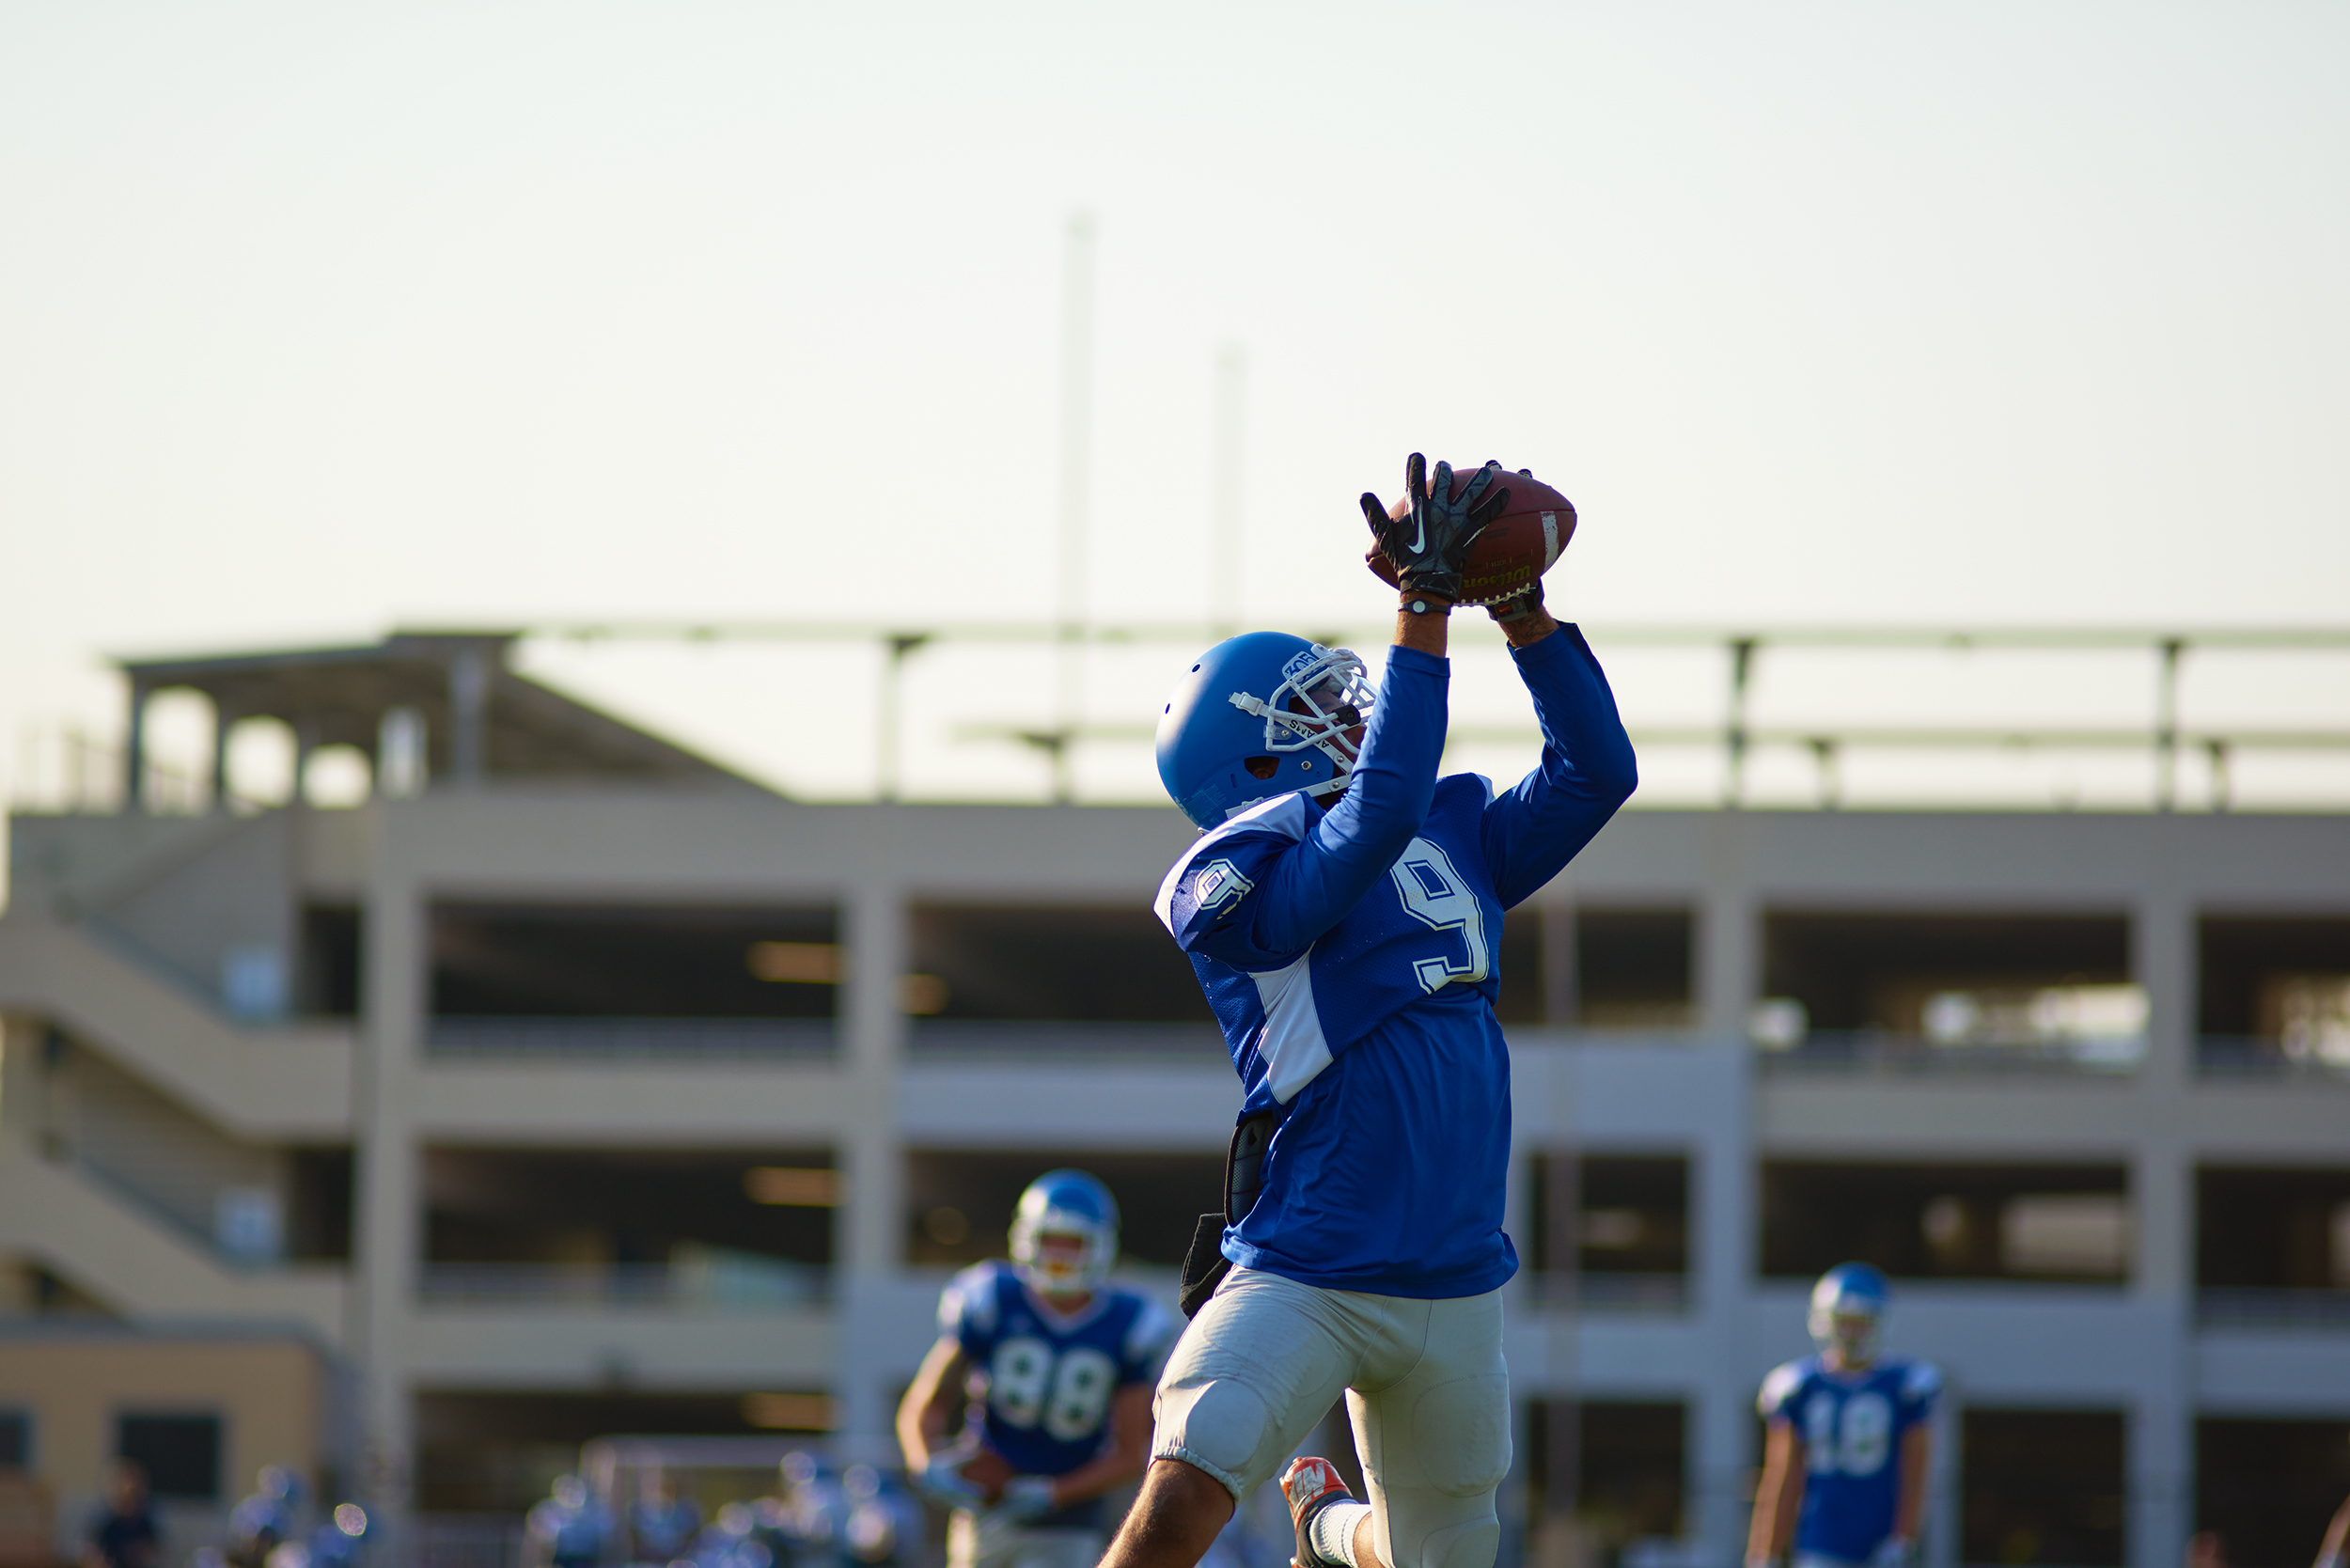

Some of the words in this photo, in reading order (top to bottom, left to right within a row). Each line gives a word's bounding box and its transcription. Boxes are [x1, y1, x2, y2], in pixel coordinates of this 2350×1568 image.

[1463, 564, 1532, 588] Wilson
[1289, 719, 1329, 748] AAMS
[1194, 858, 1255, 920] 9
[1389, 836, 1490, 996] 9
[990, 1334, 1119, 1443] 88
